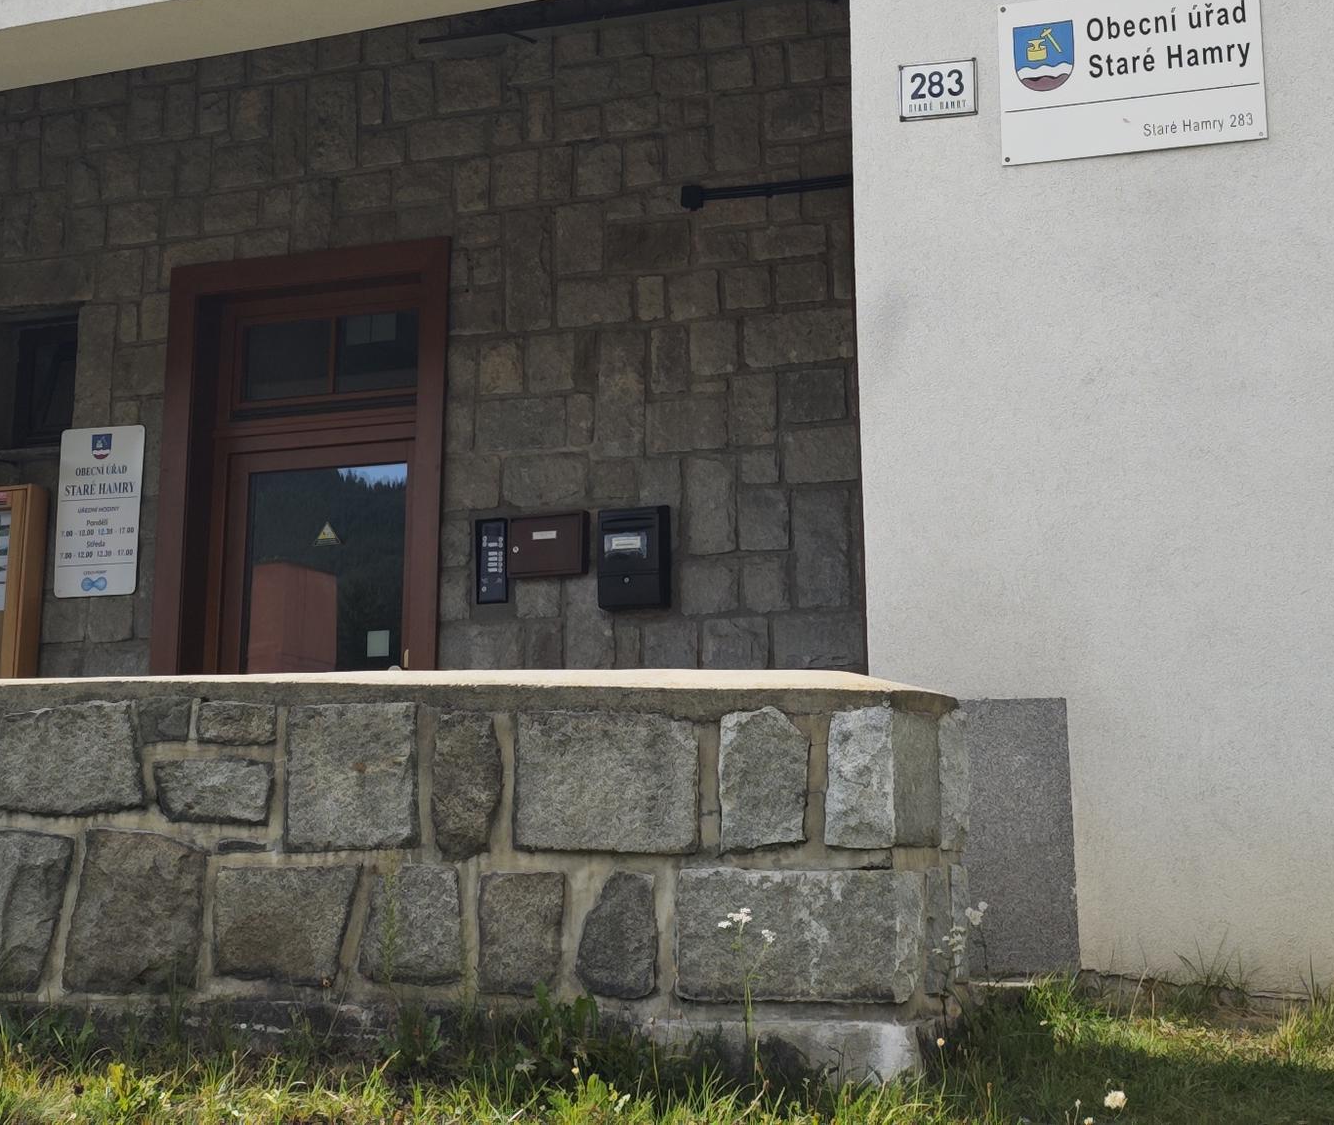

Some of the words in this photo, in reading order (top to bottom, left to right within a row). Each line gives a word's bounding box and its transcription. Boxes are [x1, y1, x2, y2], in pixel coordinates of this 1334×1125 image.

[1086, 6, 1178, 42] Obecní
[1088, 47, 1156, 79] Staré
[1166, 39, 1251, 69] Hamry
[910, 68, 965, 100] 283
[1143, 119, 1178, 138] Staré
[1182, 115, 1225, 133] Hamry
[1229, 112, 1254, 128] 283
[75, 464, 105, 476] OBECNÍ
[65, 479, 97, 496] STARÉ
[98, 481, 136, 495] HAMRY
